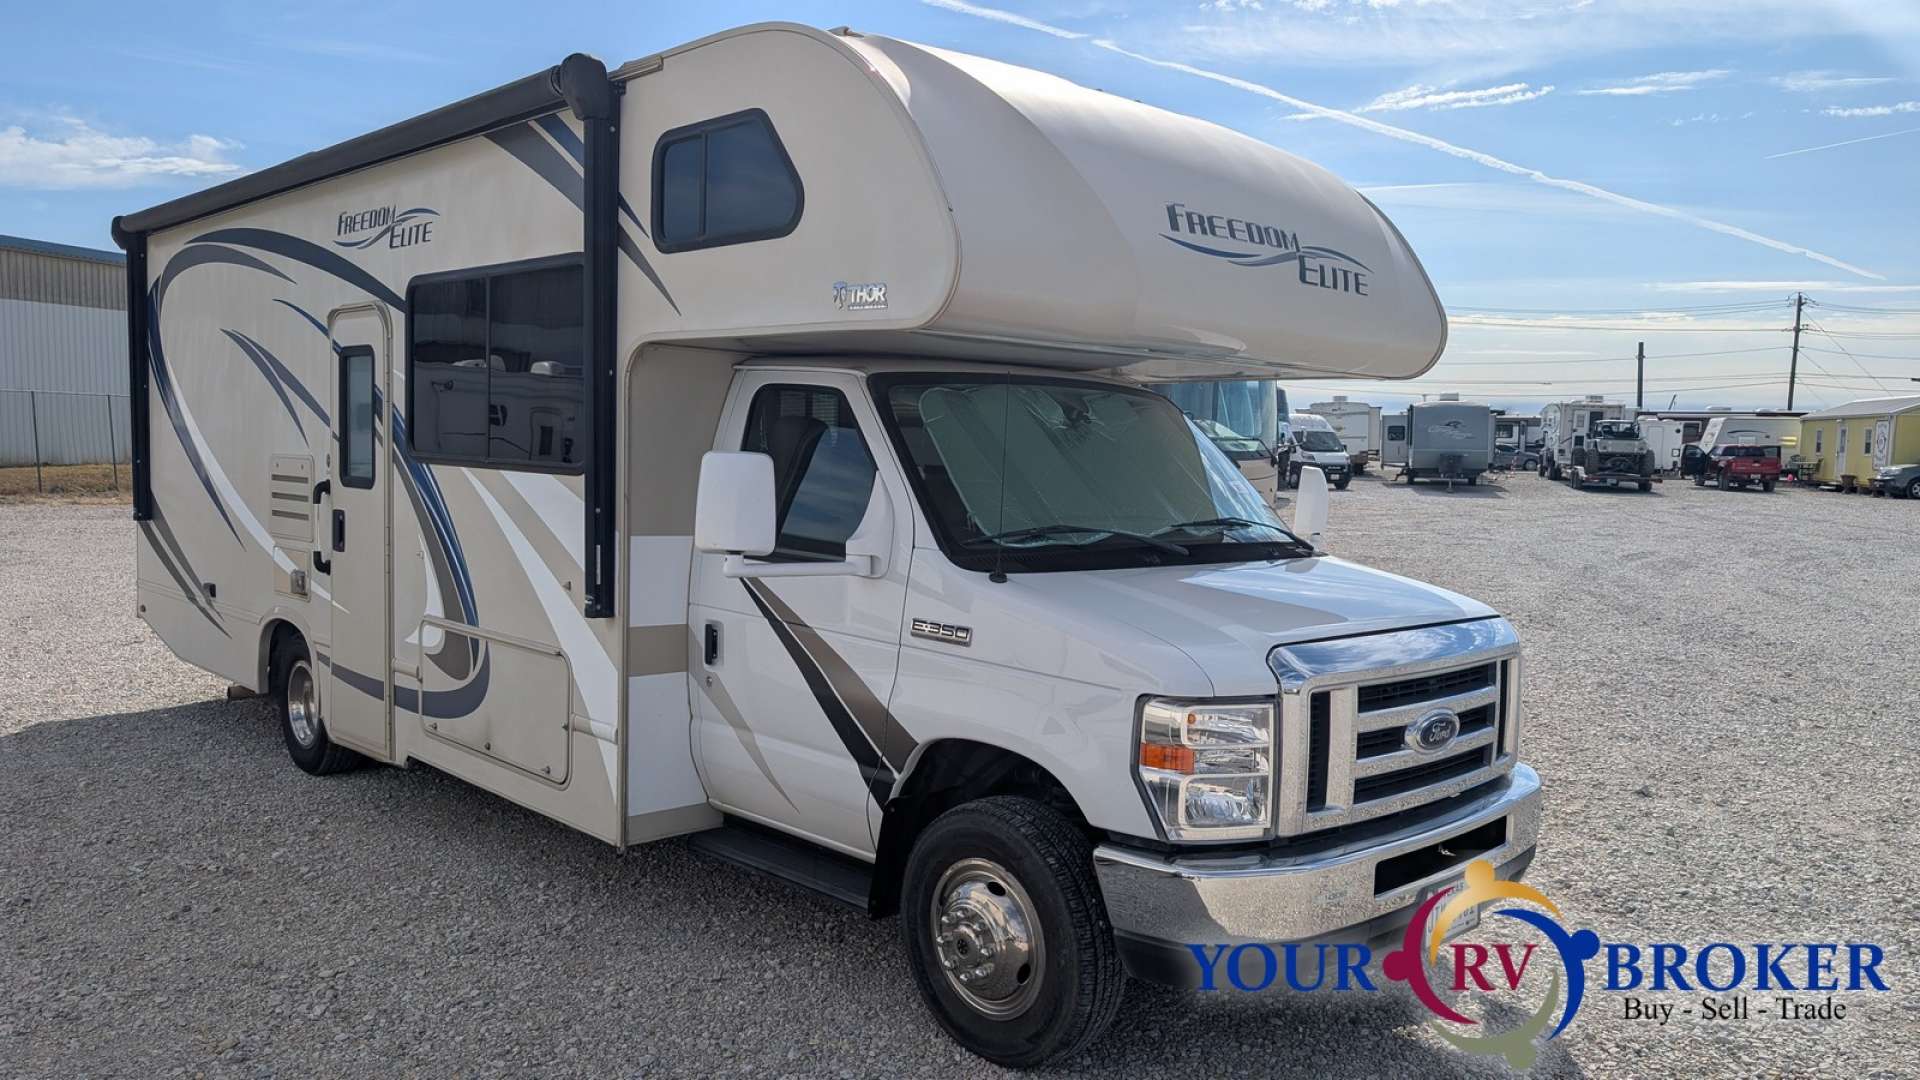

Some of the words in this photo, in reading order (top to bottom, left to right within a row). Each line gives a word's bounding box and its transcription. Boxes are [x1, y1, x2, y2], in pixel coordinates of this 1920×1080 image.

[337, 205, 396, 236] FREEDOM
[389, 221, 432, 249] ELITE
[1166, 203, 1300, 252] FREEDOM
[1299, 255, 1369, 296] ELITE
[849, 284, 887, 304] THOR
